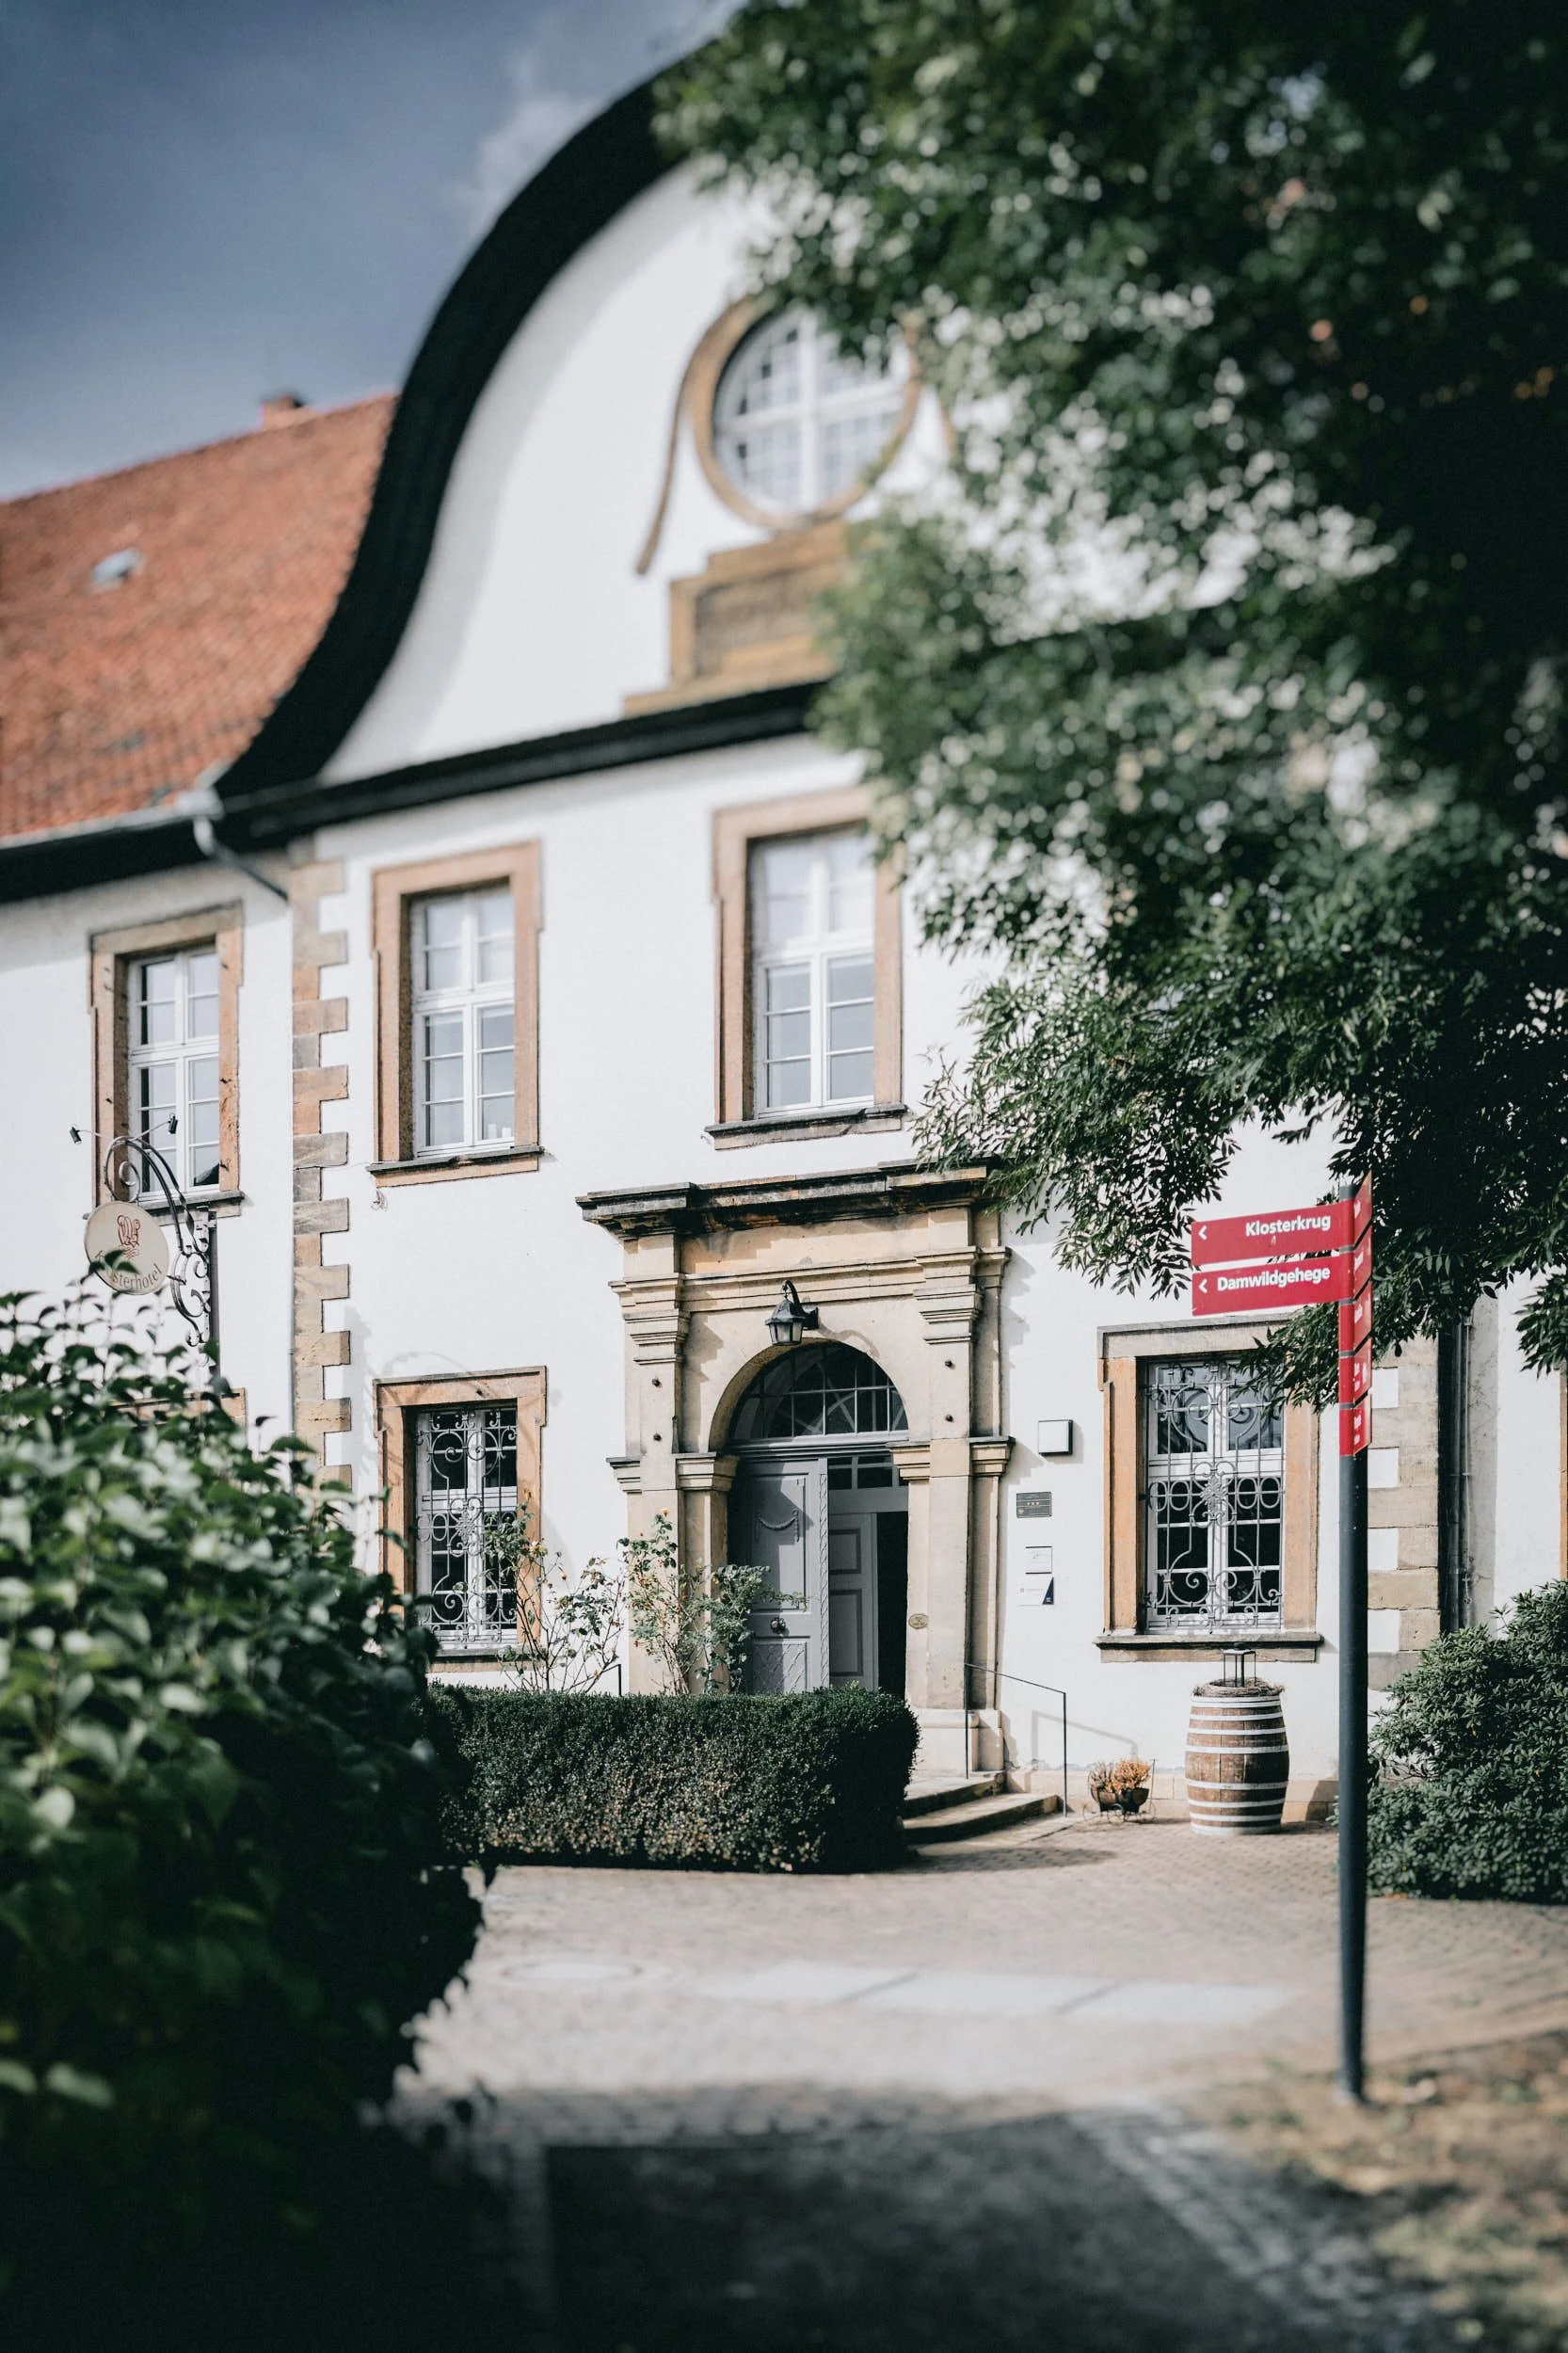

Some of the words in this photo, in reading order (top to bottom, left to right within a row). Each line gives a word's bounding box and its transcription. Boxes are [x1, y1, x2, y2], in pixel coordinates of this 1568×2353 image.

[1245, 1214, 1331, 1237] Klosterkrug
[95, 1250, 163, 1289] Ksterhotel
[1217, 1266, 1330, 1291] Damwildgehege
